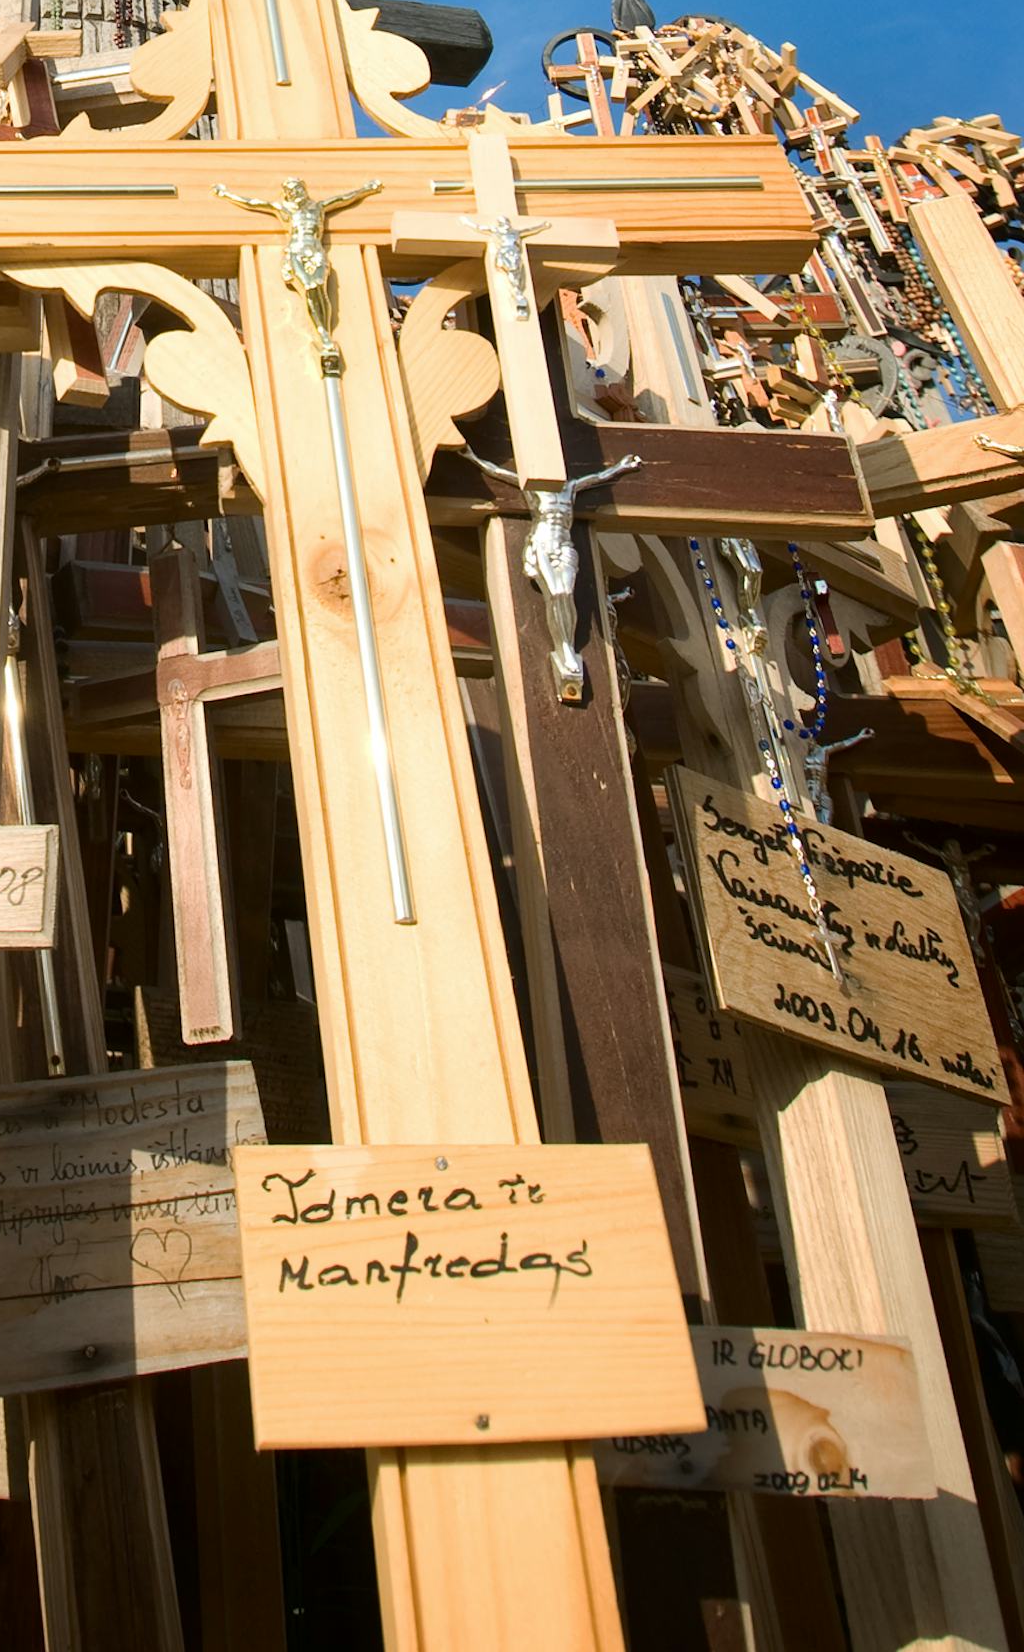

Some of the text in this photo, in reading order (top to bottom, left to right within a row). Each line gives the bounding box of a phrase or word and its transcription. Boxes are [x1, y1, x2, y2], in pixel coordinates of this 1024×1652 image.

[80, 1079, 205, 1128] Modesta
[712, 1339, 738, 1367] IR
[753, 1470, 810, 1495] 2009
